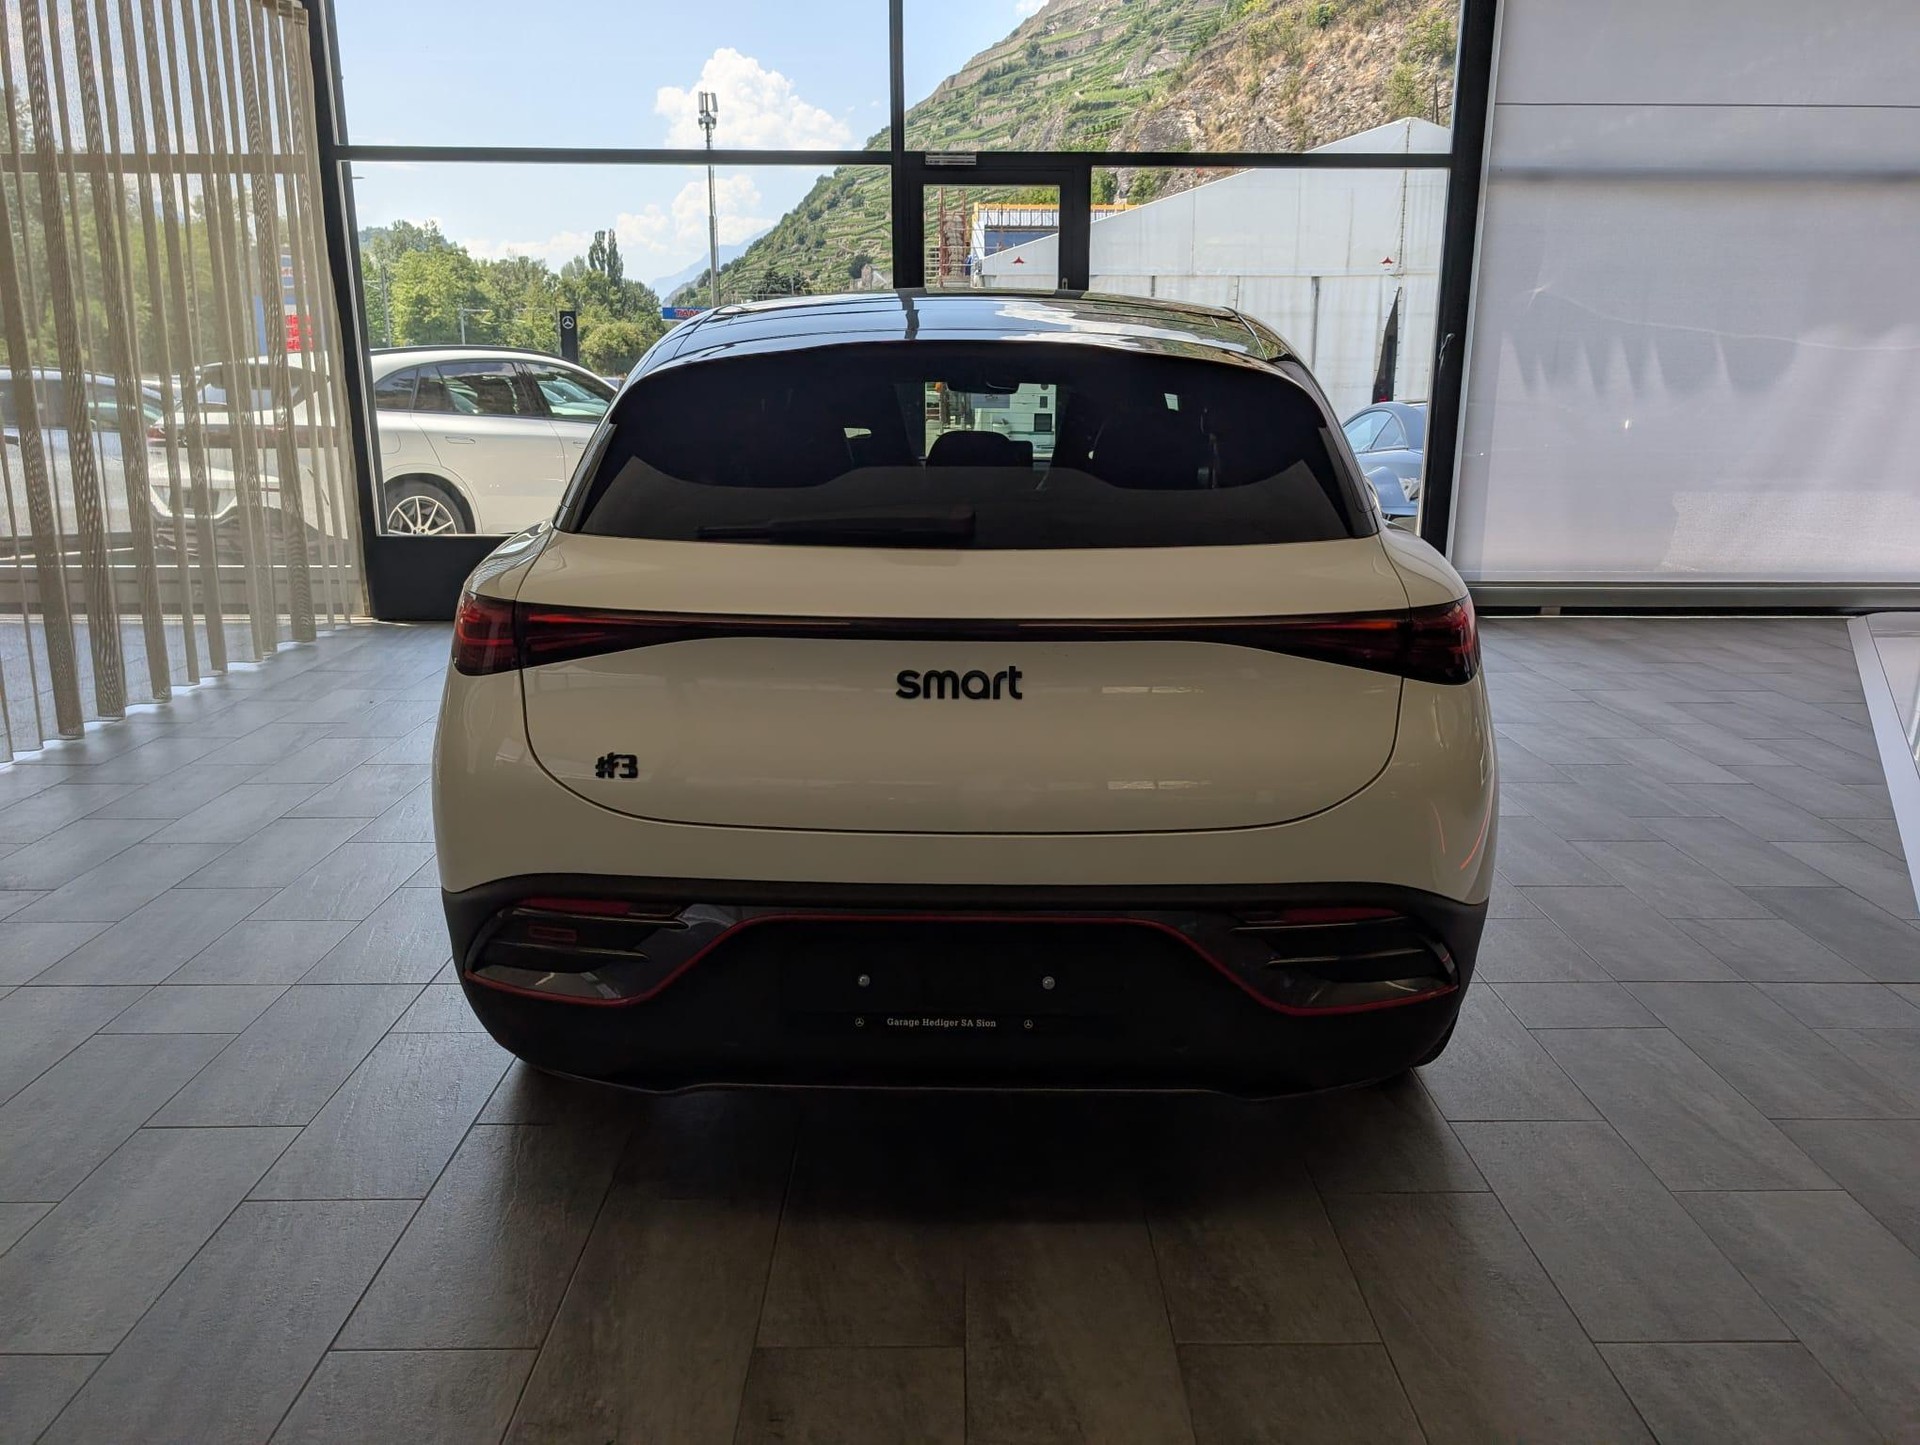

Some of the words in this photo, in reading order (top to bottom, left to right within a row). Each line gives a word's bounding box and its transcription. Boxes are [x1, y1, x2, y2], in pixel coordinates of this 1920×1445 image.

[896, 666, 1022, 700] smart
[595, 752, 638, 779] #3
[887, 1018, 919, 1028] Garage
[922, 1018, 959, 1028] Hediger
[961, 1019, 974, 1027] SA
[976, 1019, 996, 1027] Sion
